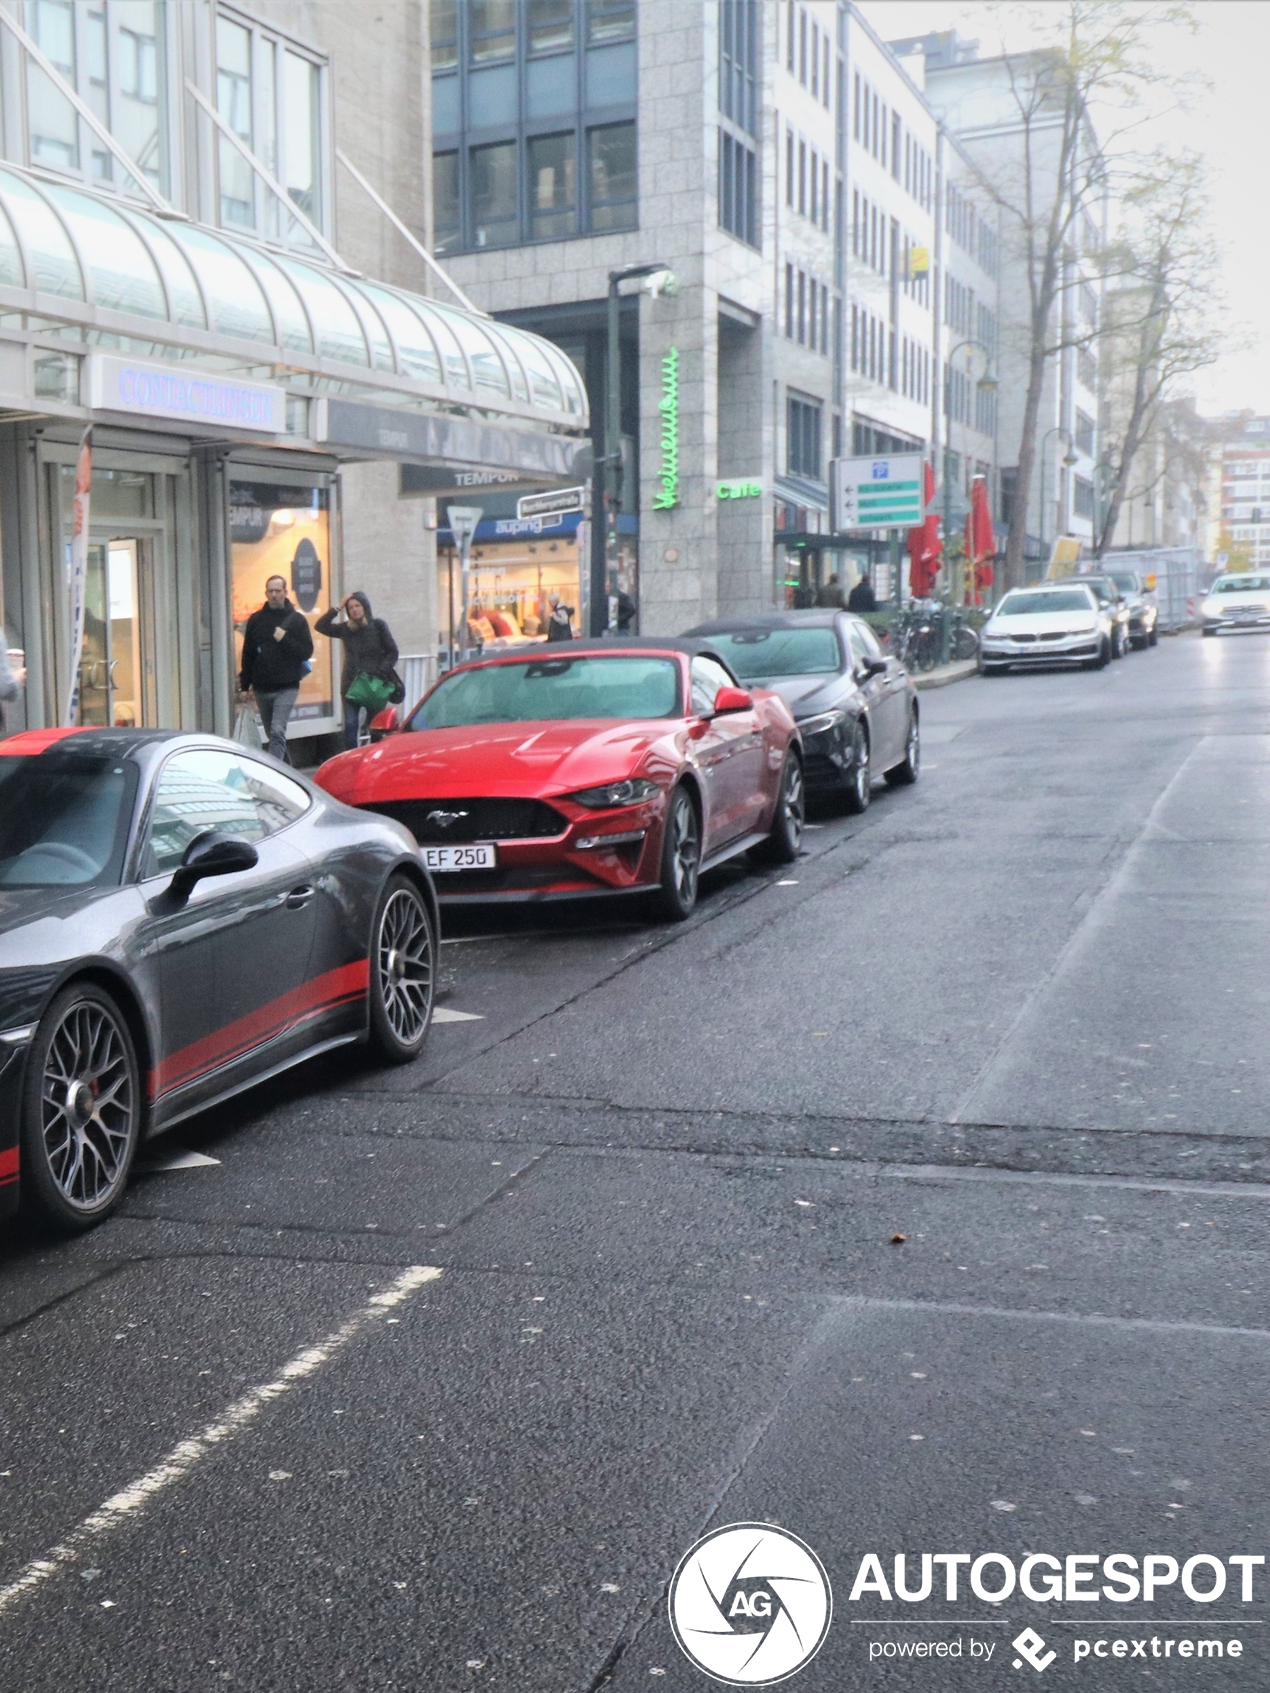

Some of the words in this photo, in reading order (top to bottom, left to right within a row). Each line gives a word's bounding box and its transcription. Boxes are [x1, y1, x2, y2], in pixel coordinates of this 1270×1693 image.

[118, 367, 275, 424] CONTACTLINSEN
[716, 481, 761, 499] Cafe
[230, 506, 263, 527] EMPUR
[496, 519, 542, 535] auping
[427, 849, 448, 867] EF
[454, 848, 487, 866] 250
